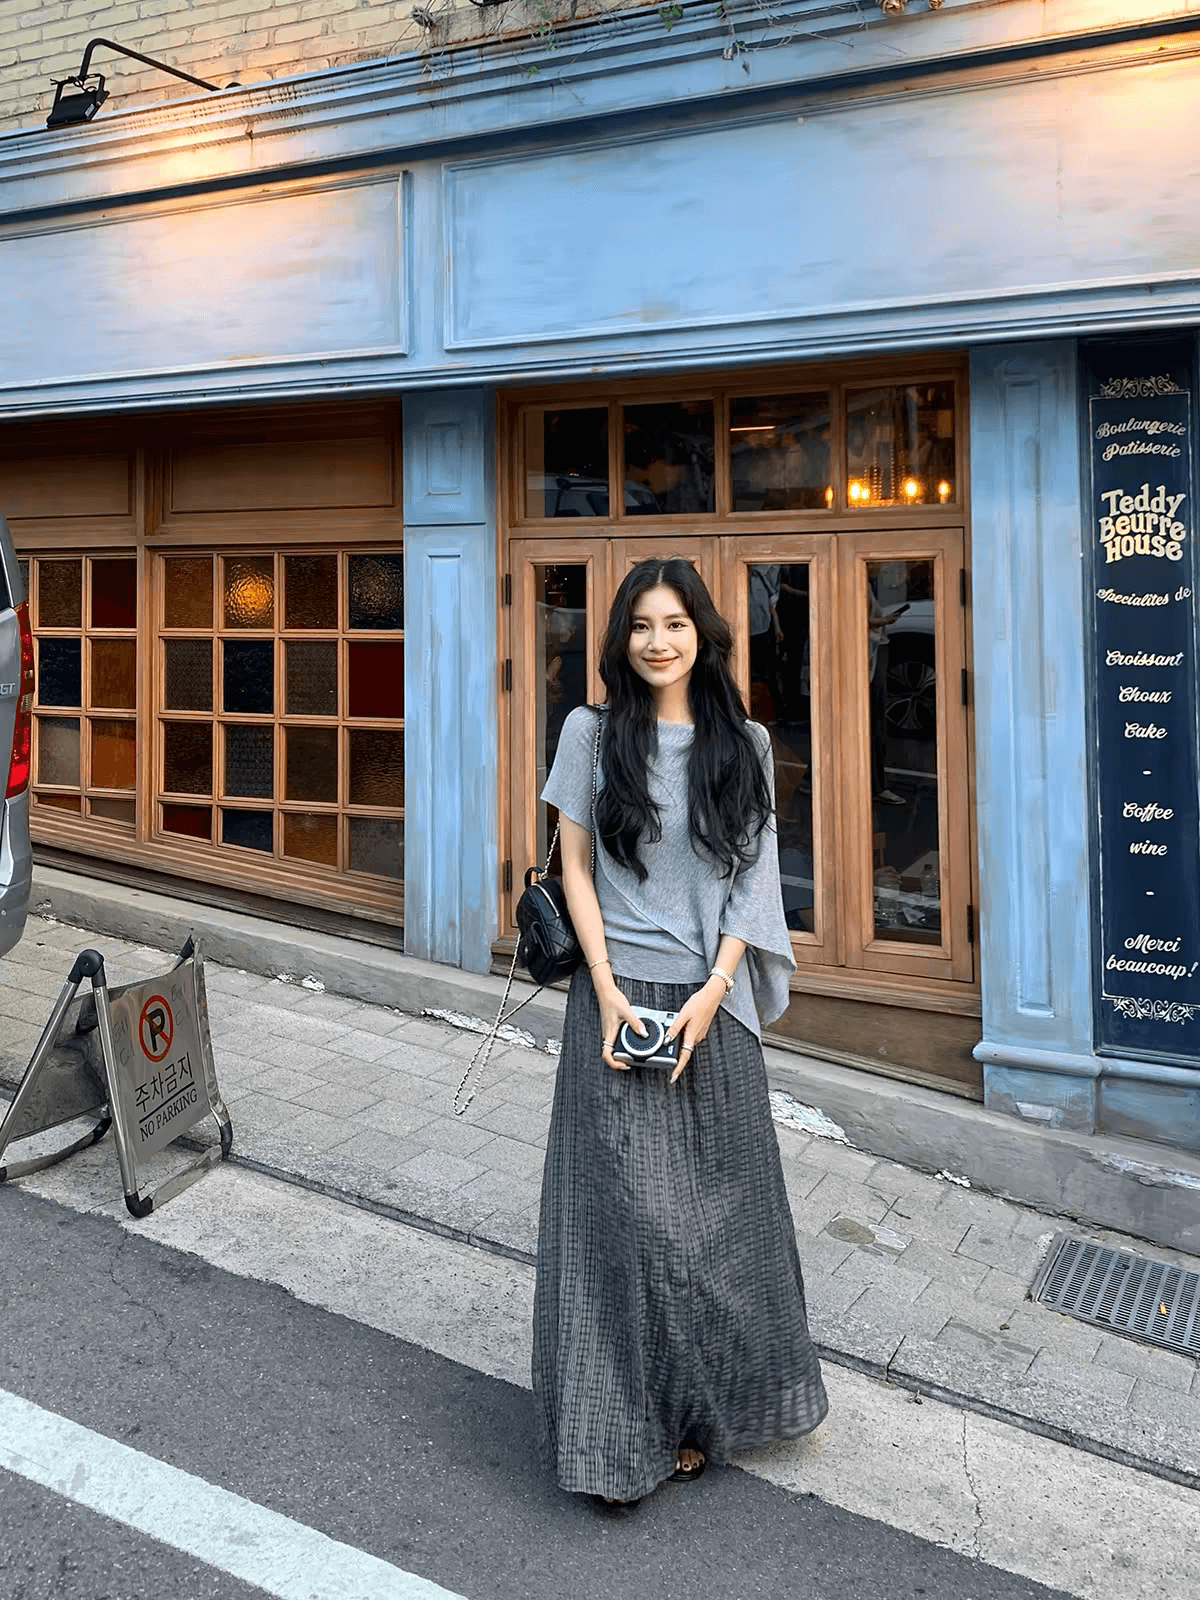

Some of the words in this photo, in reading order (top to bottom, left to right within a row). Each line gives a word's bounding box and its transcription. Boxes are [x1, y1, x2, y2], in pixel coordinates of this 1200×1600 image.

[1095, 417, 1187, 440] Boulangerie
[1101, 440, 1182, 462] Patisserie
[1100, 483, 1187, 518] Teddy
[1098, 512, 1187, 543] Beurre
[1174, 586, 1192, 602] de
[1105, 650, 1184, 667] Croissant
[1118, 686, 1172, 704] Choux
[1124, 722, 1168, 739] Cake
[1122, 802, 1174, 822] Coffee
[1129, 840, 1168, 856] wine
[1124, 934, 1182, 954] Merci
[134, 1052, 193, 1112] 주차금지
[139, 1120, 155, 1142] NO
[156, 1088, 198, 1130] PARKING
